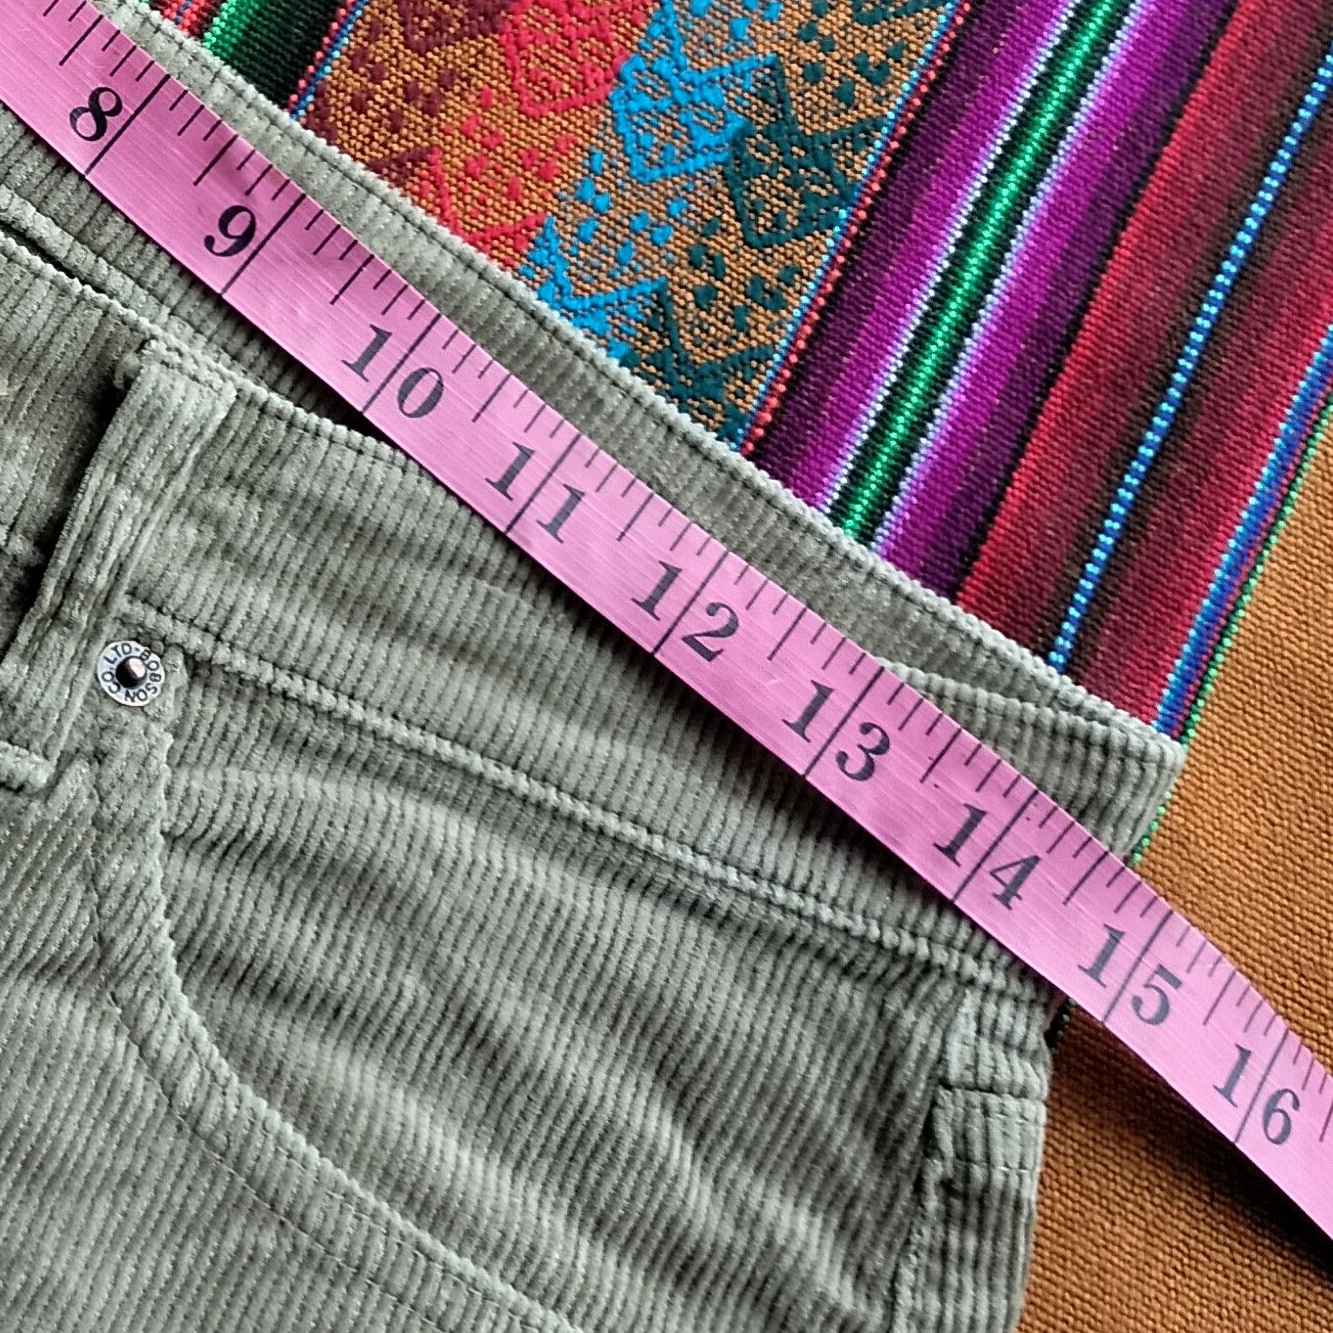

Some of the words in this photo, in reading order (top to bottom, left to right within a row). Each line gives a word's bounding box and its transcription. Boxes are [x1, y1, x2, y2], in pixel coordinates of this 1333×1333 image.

[68, 87, 123, 142] 8
[205, 205, 256, 258] 9
[342, 324, 445, 420] 10
[486, 442, 588, 540] 11
[632, 561, 740, 661] 12
[124, 649, 162, 703] BOBSON
[781, 680, 891, 783] 13
[934, 805, 1043, 910] 14
[1077, 928, 1183, 1027] 15
[1212, 1049, 1303, 1145] 16
